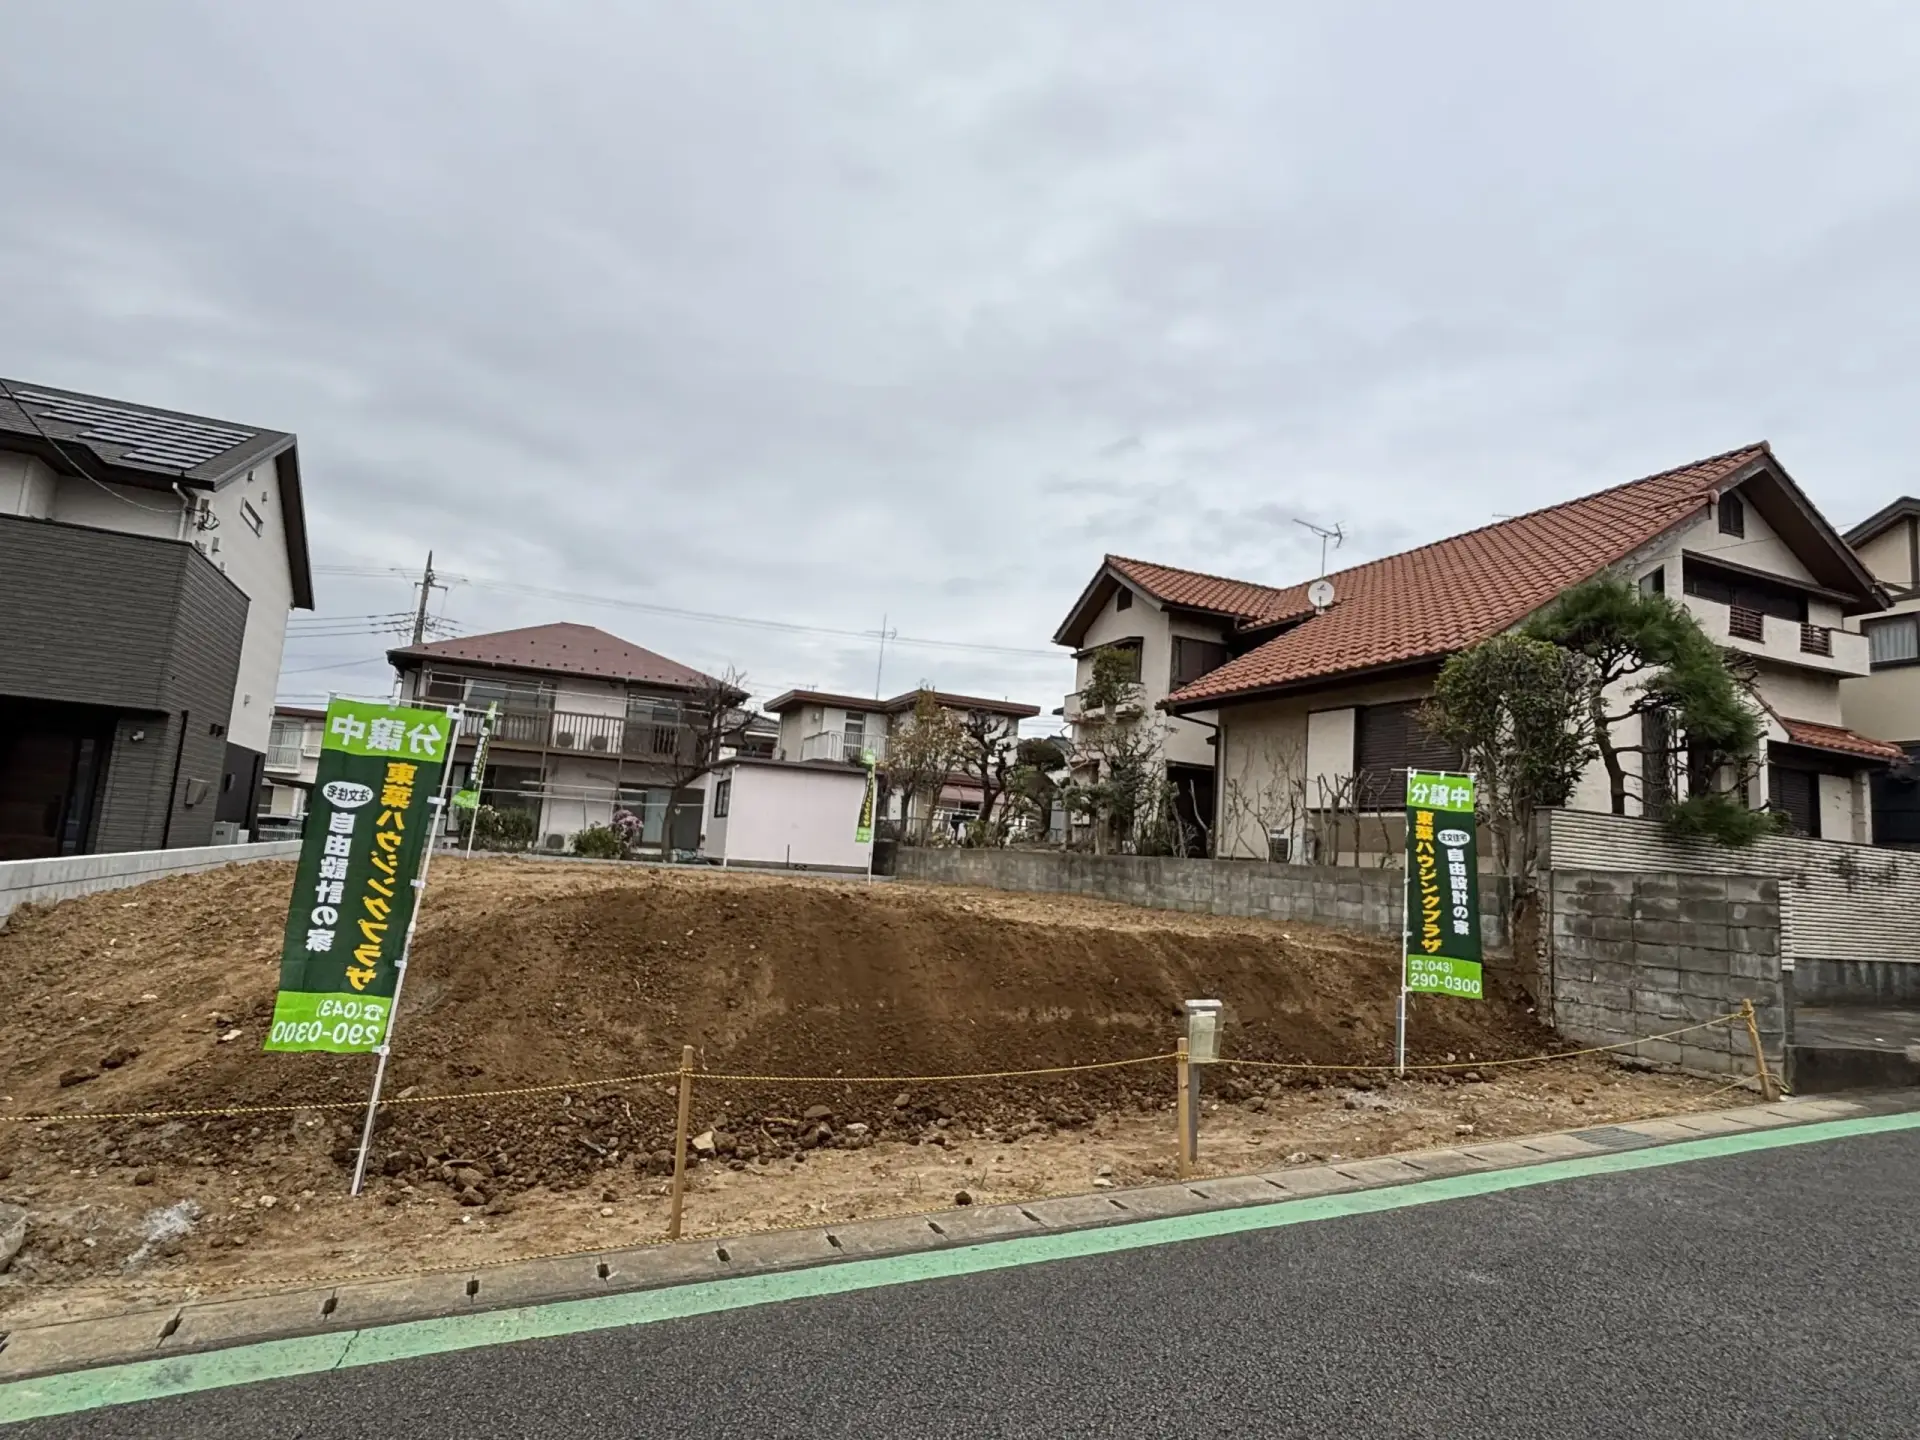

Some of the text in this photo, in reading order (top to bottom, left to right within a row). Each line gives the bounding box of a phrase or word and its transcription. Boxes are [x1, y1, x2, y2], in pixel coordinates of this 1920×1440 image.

[1411, 783, 1470, 808] 分譲中
[1415, 810, 1442, 953] 東葉ハウジングプラザ
[1447, 848, 1470, 936] 自由設計の家
[1424, 960, 1453, 974] (043)
[1410, 973, 1480, 994] 290-0300
